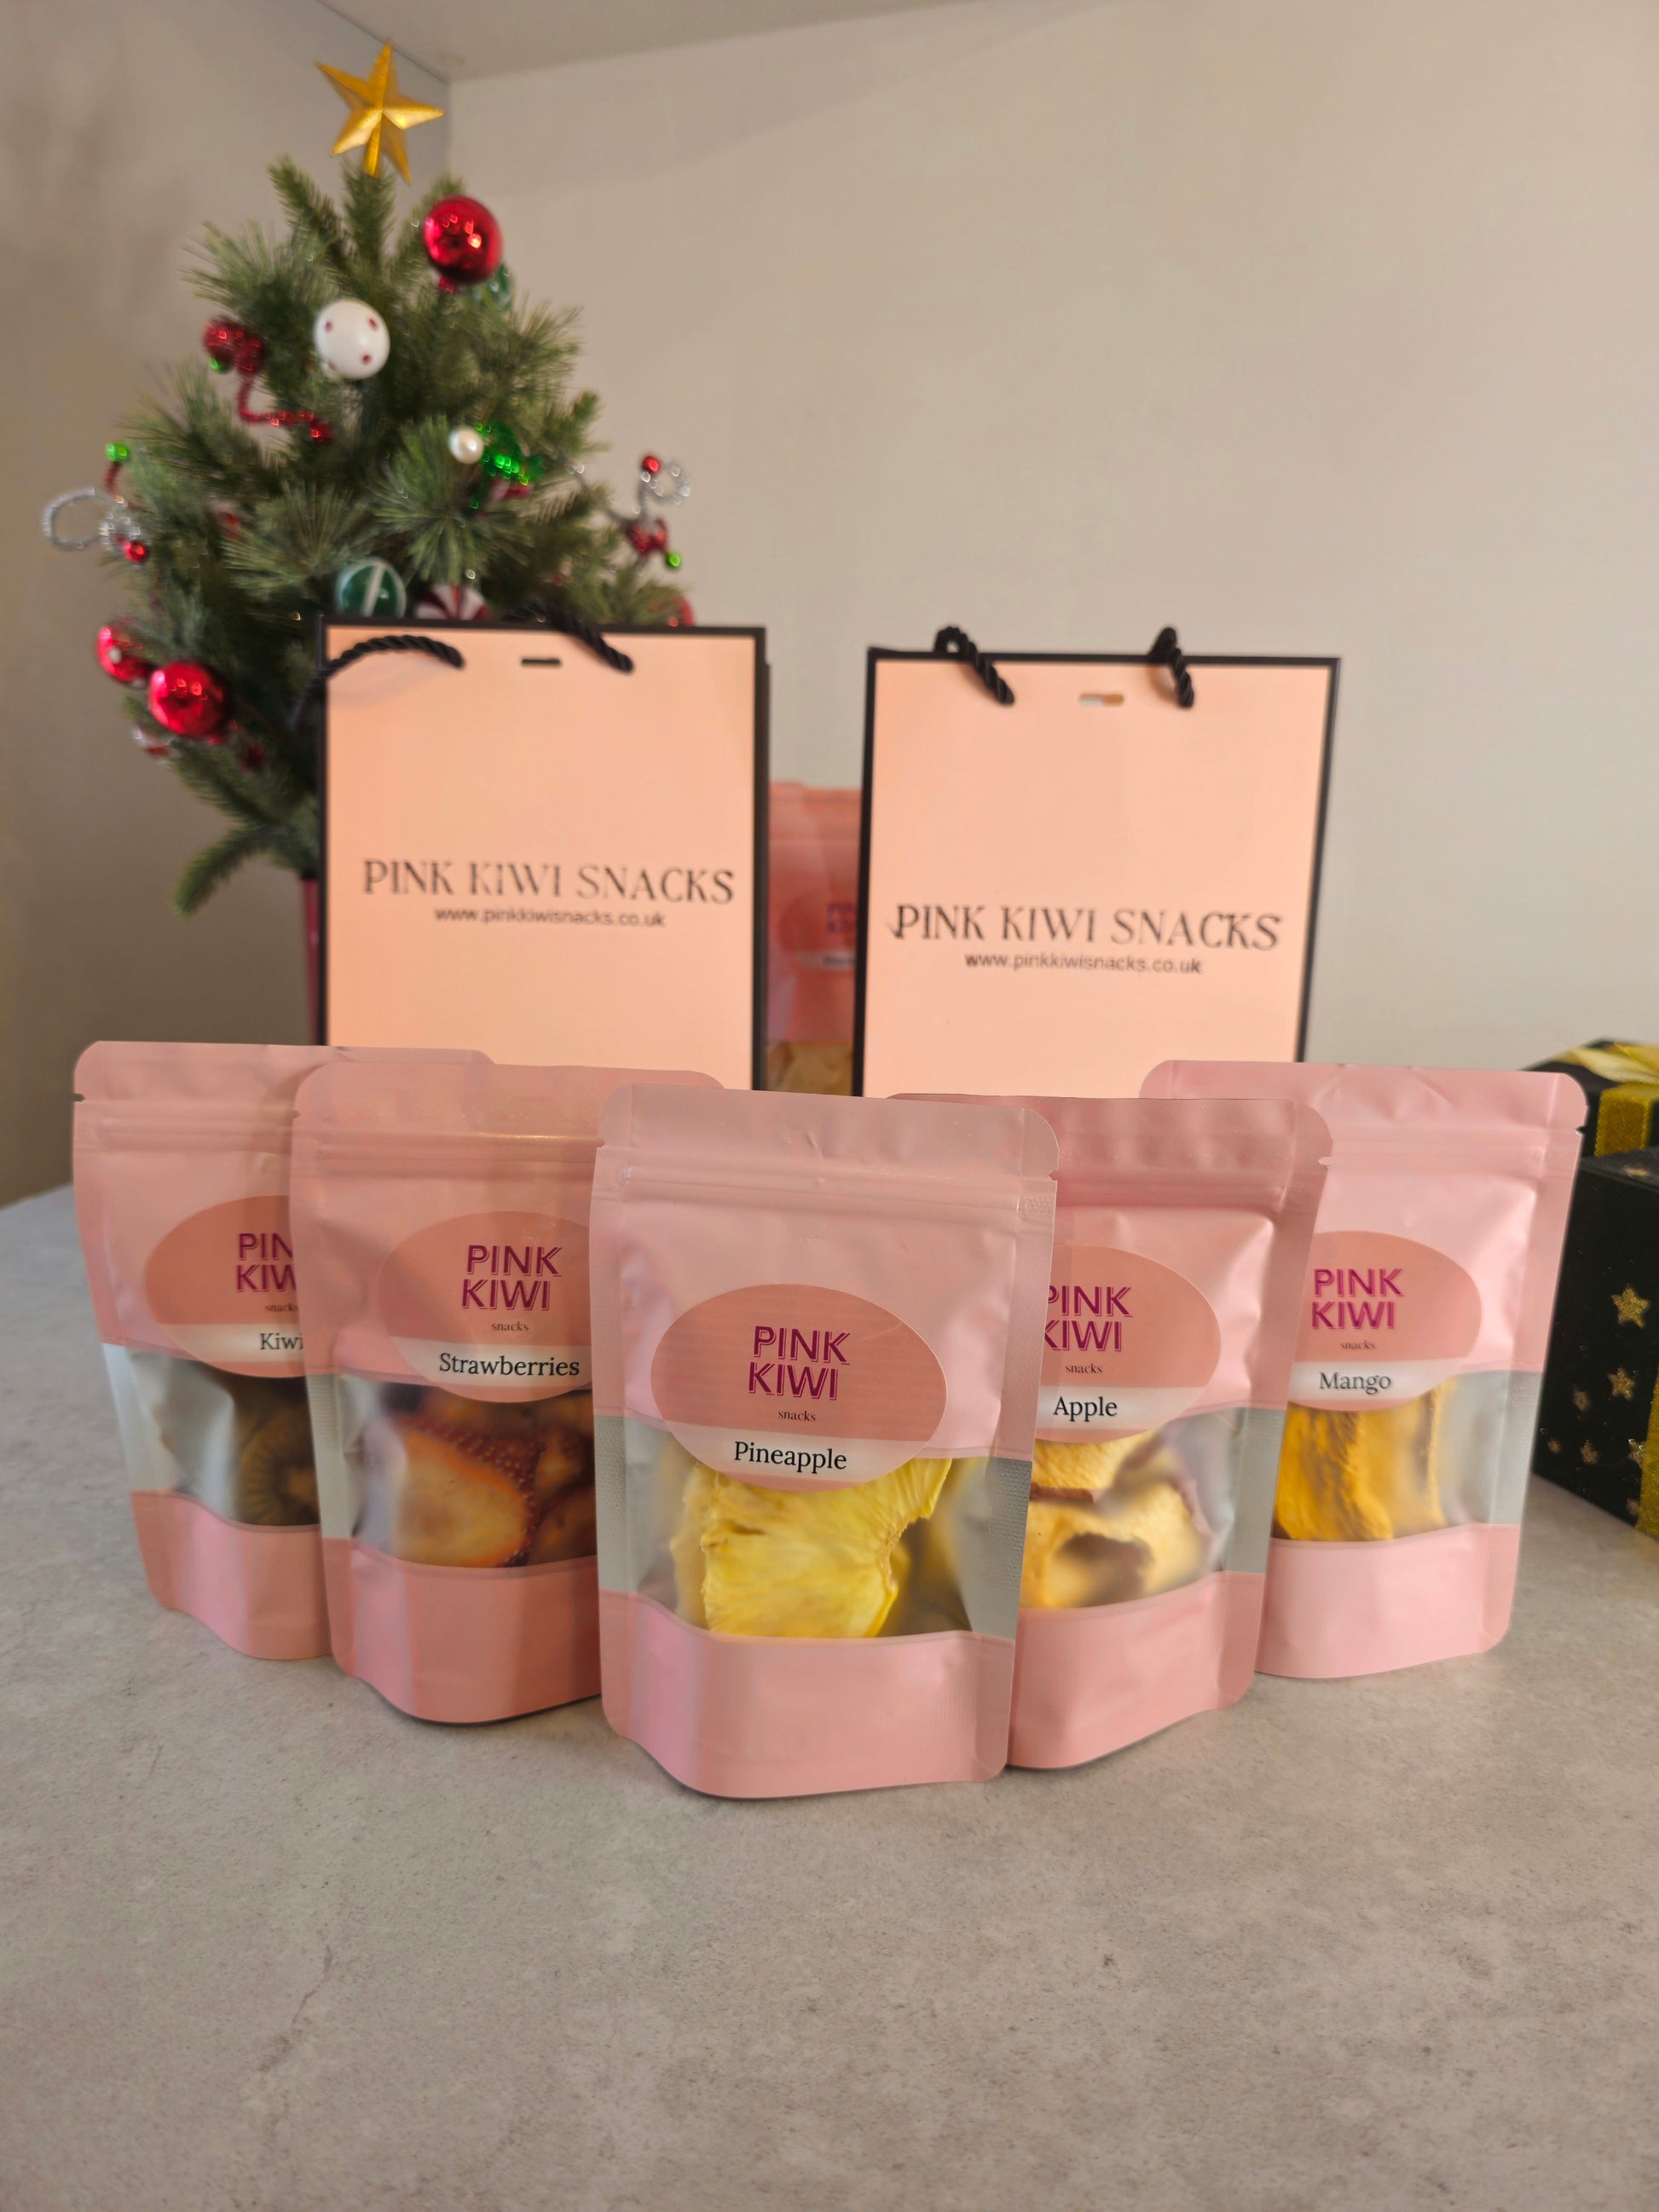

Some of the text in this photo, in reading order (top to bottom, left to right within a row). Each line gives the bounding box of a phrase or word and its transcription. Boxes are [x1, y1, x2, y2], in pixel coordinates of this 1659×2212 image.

[364, 859, 735, 904] PINK KIWI SNACKS
[435, 908, 665, 927] www.pinkkiwisnacks.co.uk
[894, 904, 986, 940] PINK
[1001, 905, 1096, 943] KIWI
[1110, 908, 1283, 950] SNACKS
[964, 952, 1203, 974] www.pinkkiwisnacks.co.uk
[239, 1233, 294, 1260] PIN
[466, 1245, 563, 1277] PINK
[236, 1264, 297, 1291] KIW
[1314, 1268, 1405, 1297] PINK
[462, 1279, 550, 1310] KIWI
[491, 1321, 529, 1331] snacks
[1311, 1301, 1395, 1330] KIWI
[754, 1325, 850, 1365] PINK
[1340, 1340, 1376, 1349] snacks
[439, 1353, 580, 1376] Strawberries
[1066, 1363, 1102, 1374] snacks
[749, 1361, 838, 1401] KIWI
[1319, 1372, 1391, 1395] Mango
[778, 1411, 816, 1422] snacks
[1053, 1395, 1118, 1422] Apple
[734, 1441, 847, 1474] Pineapple
